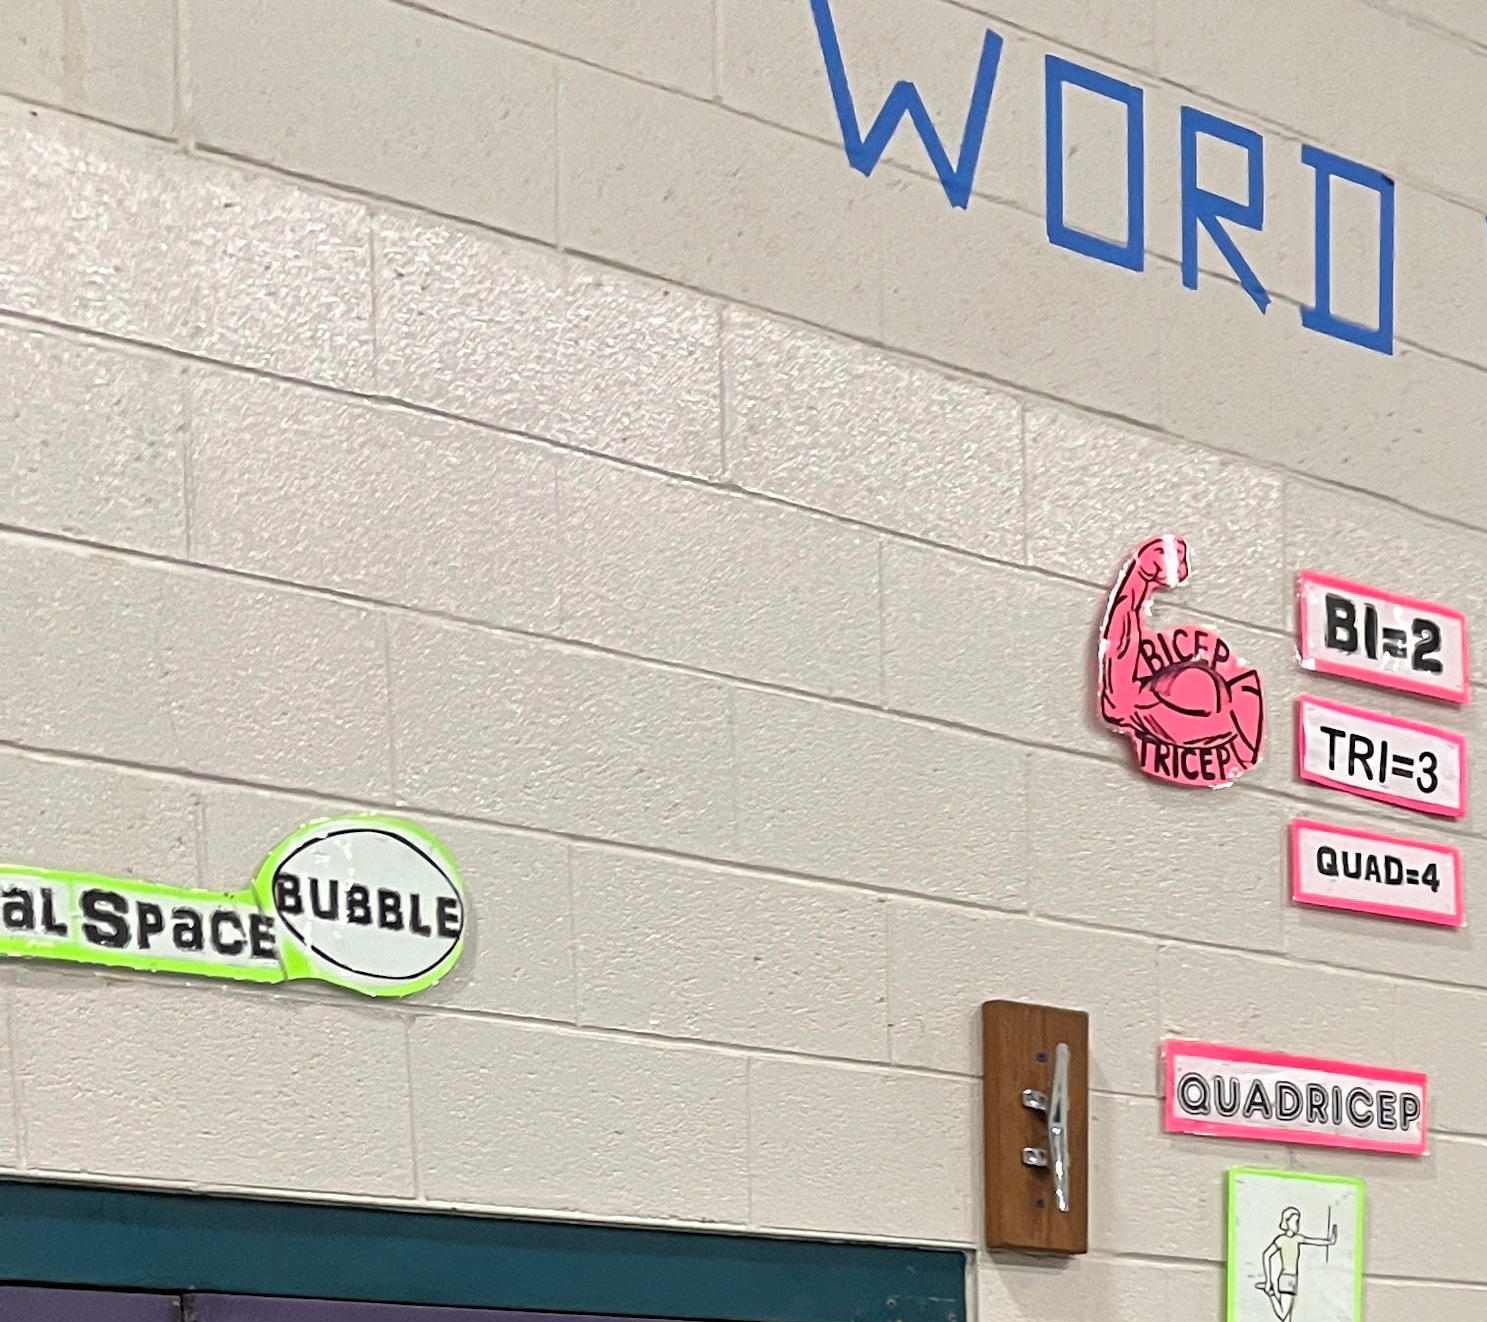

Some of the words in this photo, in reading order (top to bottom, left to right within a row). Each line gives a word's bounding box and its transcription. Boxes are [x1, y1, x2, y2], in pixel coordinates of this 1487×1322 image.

[813, 0, 1395, 355] WORD
[1140, 629, 1230, 676] BICEP
[1325, 593, 1443, 675] BI=2
[1136, 738, 1231, 781] TRICEP
[1320, 726, 1439, 794] TRI=3
[1317, 846, 1440, 892] QUAD=4
[274, 872, 461, 938] BUBBLE
[1177, 1071, 1421, 1131] QUADRICEP
